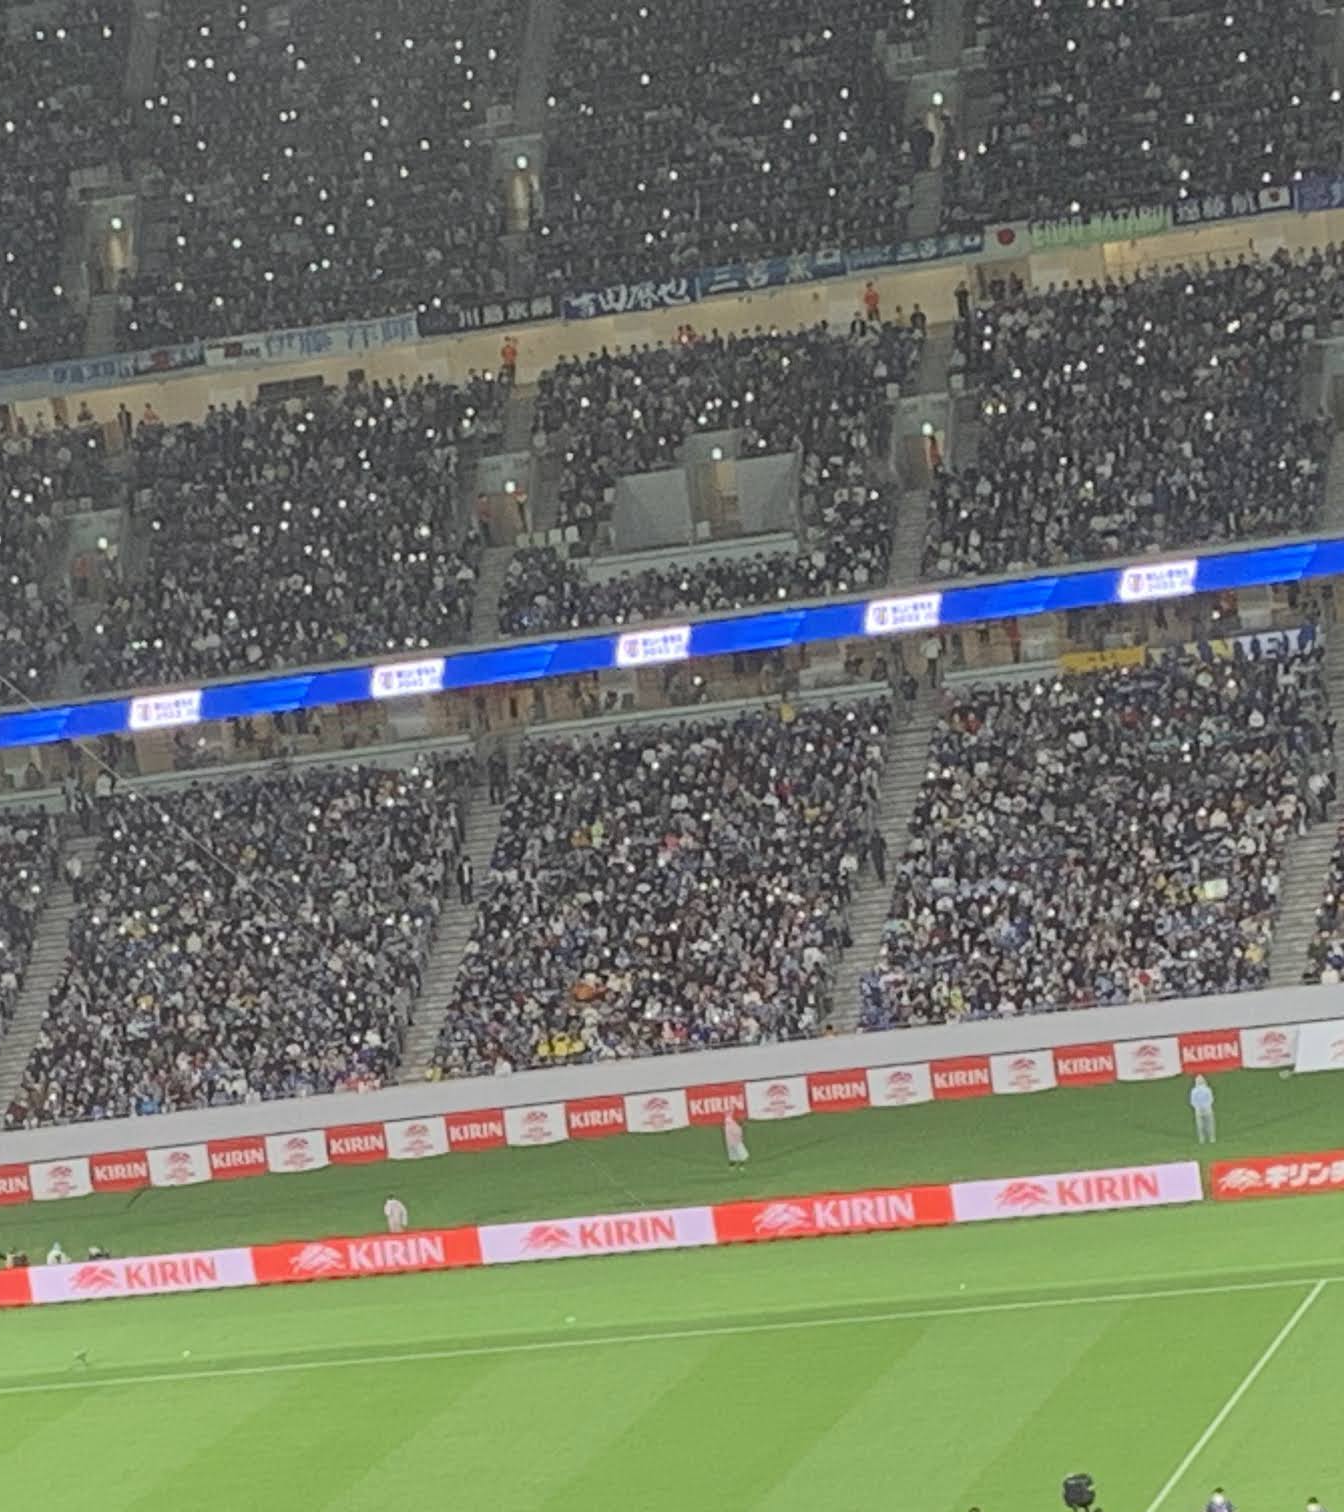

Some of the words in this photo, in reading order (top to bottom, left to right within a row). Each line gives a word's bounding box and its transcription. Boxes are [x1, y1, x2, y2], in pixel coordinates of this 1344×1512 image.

[1184, 1042, 1239, 1063] KIRIN
[1057, 1055, 1112, 1077] KIRIN
[934, 1067, 989, 1089] KIRIN
[812, 1080, 866, 1102] KIRIN
[689, 1094, 744, 1116] KIRIN
[569, 1107, 623, 1130] KIRIN
[450, 1121, 504, 1143] KIRIN
[330, 1133, 384, 1155] KIRIN
[211, 1147, 265, 1168] KIRIN
[94, 1162, 148, 1184] KIRIN
[1057, 1173, 1160, 1206] KIRIN
[814, 1192, 915, 1229] KIRIN
[579, 1215, 676, 1249] KIRIN
[347, 1235, 445, 1271] KIRIN
[125, 1257, 217, 1289] KIRIN
